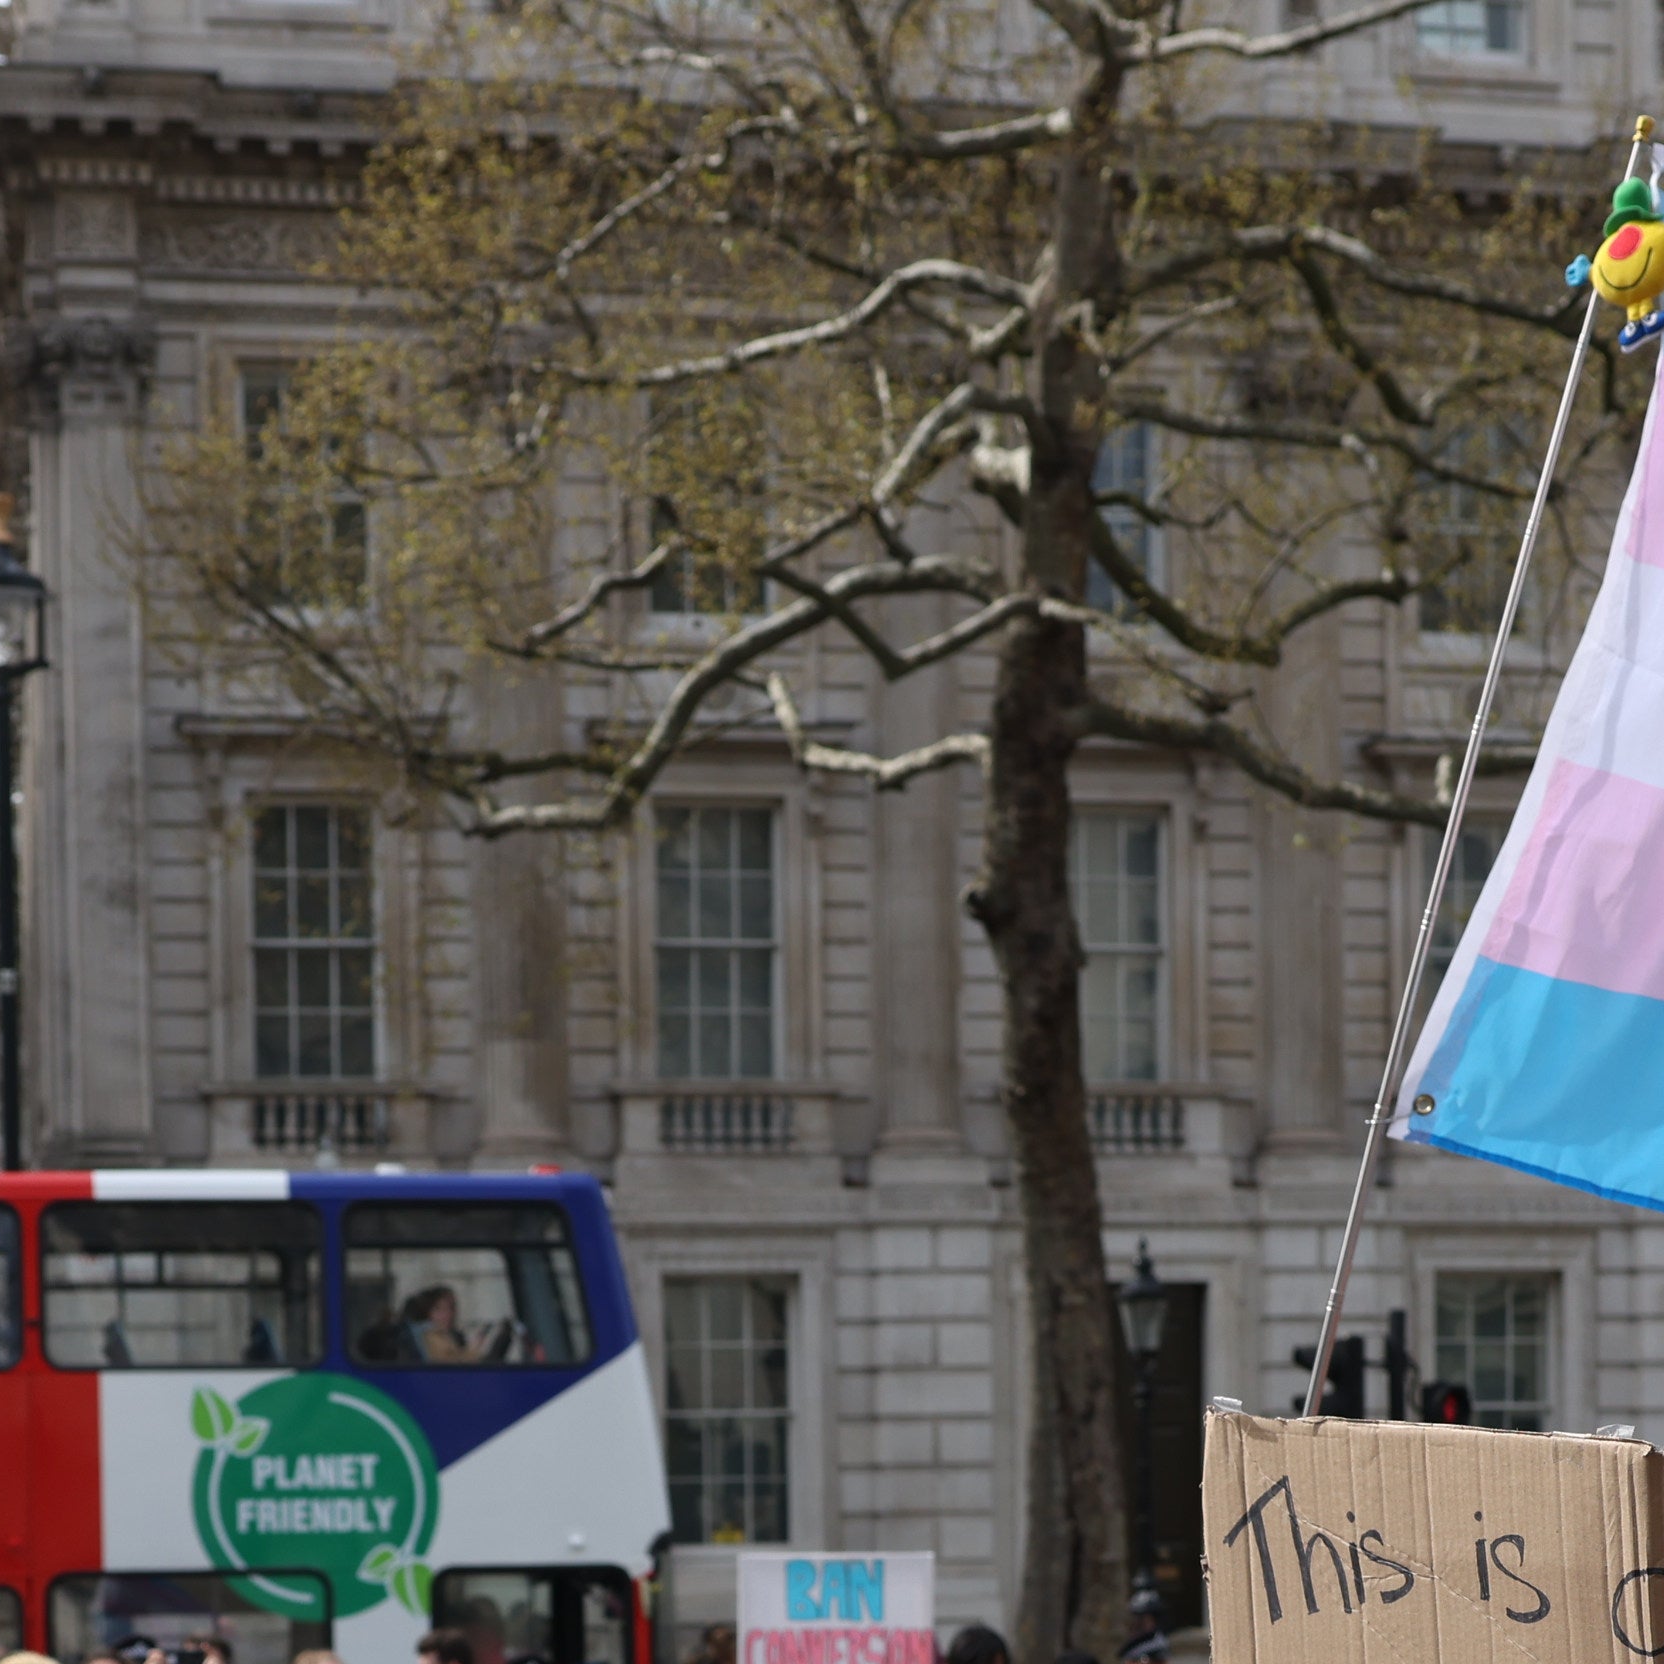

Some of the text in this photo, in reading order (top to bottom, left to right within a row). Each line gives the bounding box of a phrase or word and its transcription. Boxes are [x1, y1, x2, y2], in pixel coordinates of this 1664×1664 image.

[252, 1454, 378, 1492] PLANET
[236, 1497, 396, 1536] FRIENDLY
[1223, 1474, 1416, 1625] This
[1473, 1510, 1552, 1625] is
[786, 1558, 885, 1622] BAN
